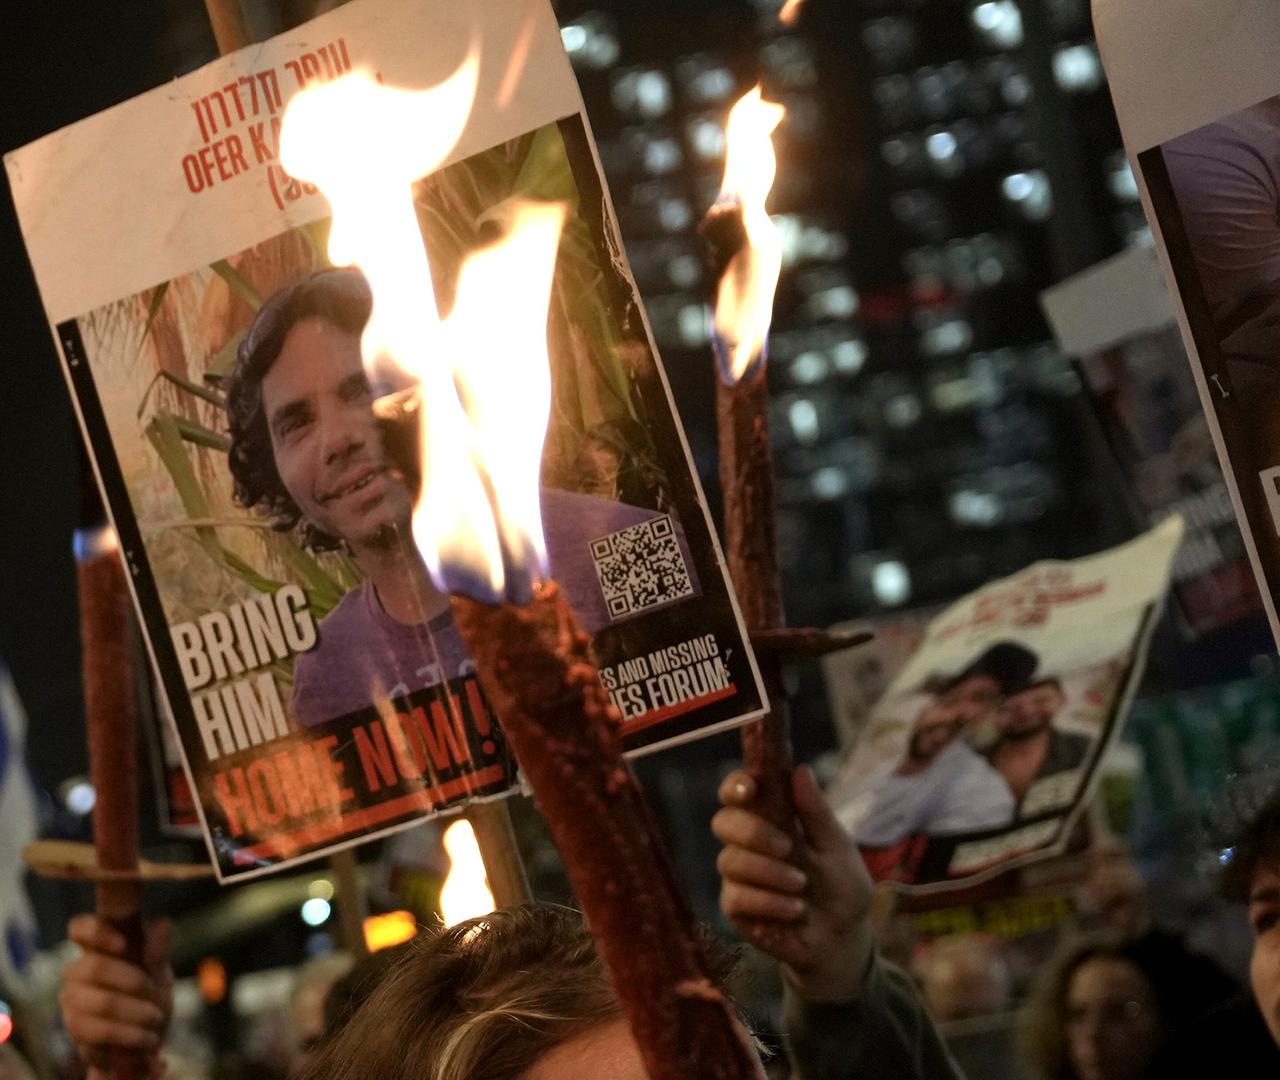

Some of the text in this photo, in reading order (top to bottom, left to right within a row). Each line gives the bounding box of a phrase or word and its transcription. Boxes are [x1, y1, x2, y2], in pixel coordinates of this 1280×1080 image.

[182, 135, 249, 193] OFER
[171, 585, 318, 690] BRING
[617, 656, 650, 687] AND
[648, 633, 719, 676] MISSING
[192, 672, 289, 762] HIM
[645, 655, 730, 712] FORUM
[214, 678, 496, 838] HOME NOW!
